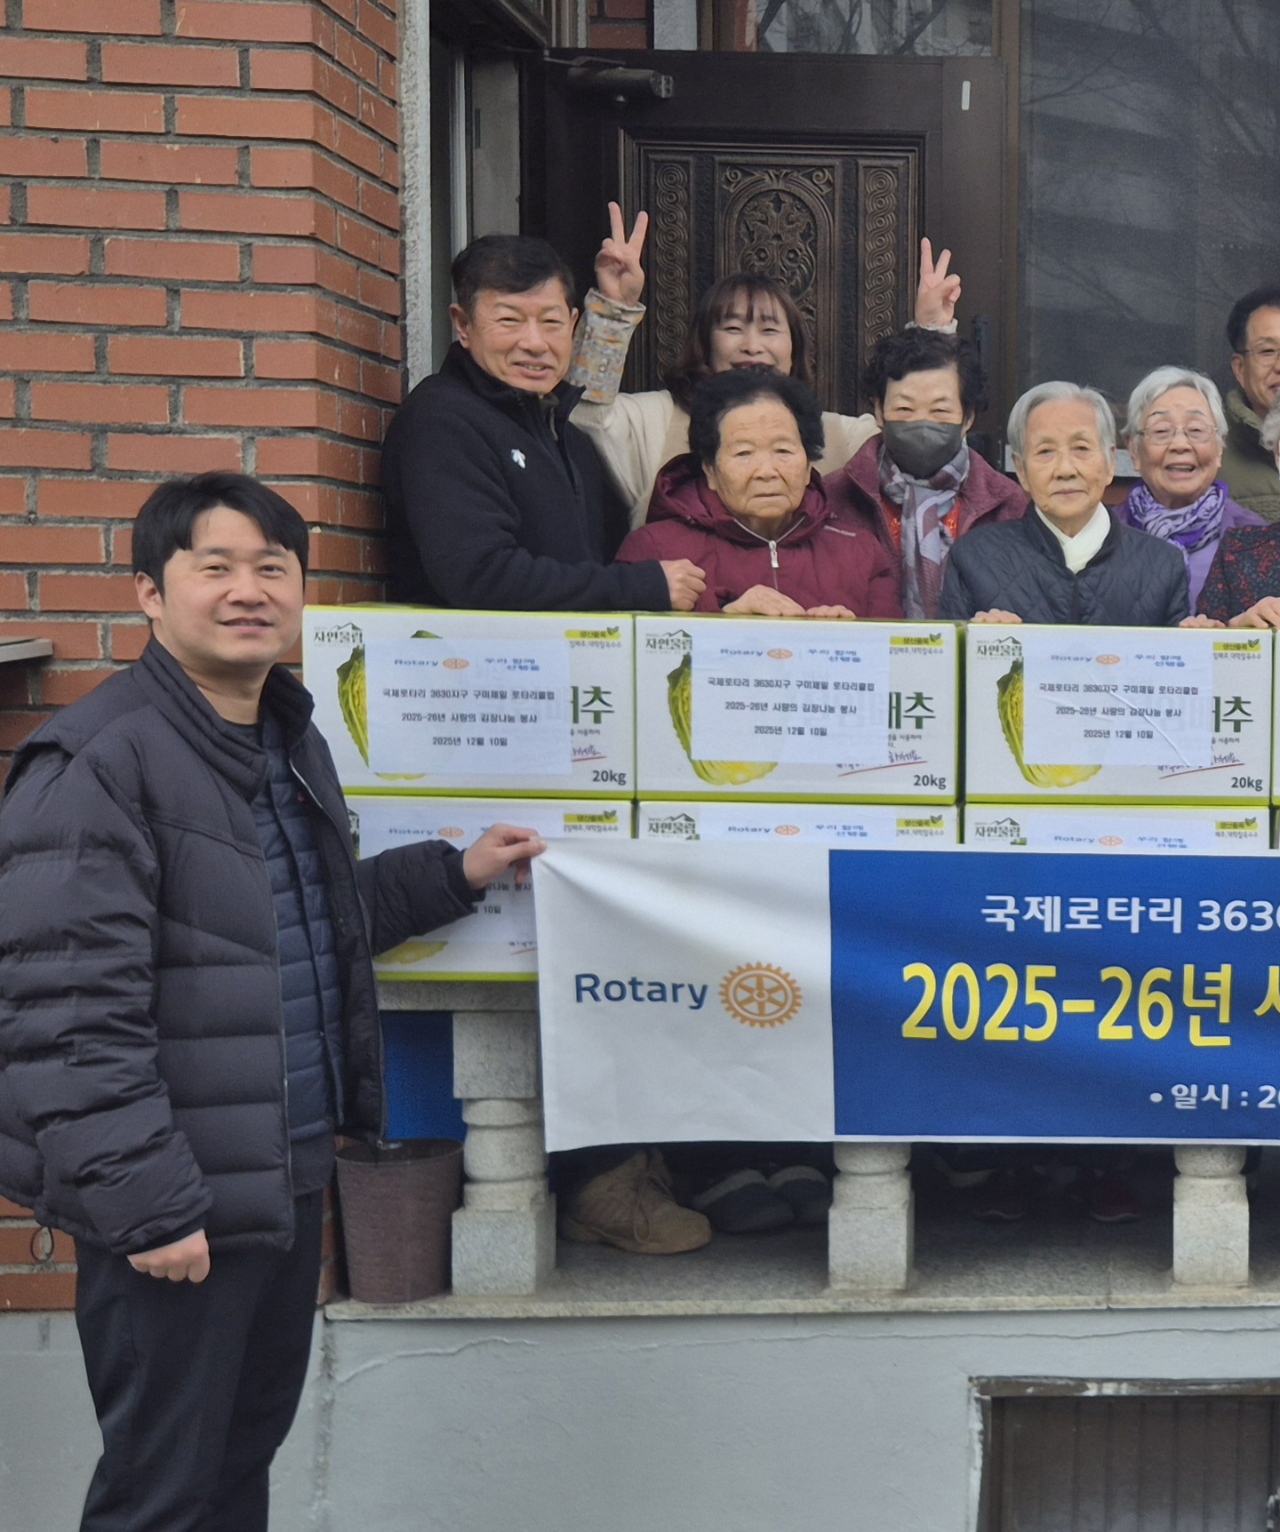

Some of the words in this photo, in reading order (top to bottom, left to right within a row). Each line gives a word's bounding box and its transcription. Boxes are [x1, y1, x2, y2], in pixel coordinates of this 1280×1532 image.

[720, 649, 763, 657] Rotary
[394, 658, 439, 667] Rotary
[1051, 655, 1092, 663] Rotary
[708, 677, 750, 687] 국제로타리
[754, 679, 791, 689] 3630지구
[795, 680, 829, 690] 구미제일
[833, 680, 875, 691] 로타리클럽
[1039, 684, 1079, 693] 국제로타리
[1083, 684, 1118, 694] 3630지구
[1123, 685, 1154, 694] 구미제일
[1158, 685, 1199, 695] 로타리클럽
[383, 689, 426, 699] 국제로타리
[430, 690, 468, 699] 3630지구
[473, 690, 507, 700] 구미제일
[512, 690, 555, 700] 로타리클럽
[725, 701, 768, 711] 2025-26년
[773, 702, 798, 712] 사랑의
[802, 703, 836, 713] 김장나눔
[840, 704, 857, 714] 봉사
[1056, 706, 1097, 715] 2025-26년
[1102, 707, 1125, 716] 사랑의
[1130, 707, 1161, 717] 김장나눔
[1166, 707, 1182, 718] 봉사
[402, 713, 446, 722] 2025-26년
[451, 713, 476, 723] 사랑의
[481, 713, 515, 723] 김장나눔
[520, 714, 537, 723] 봉사
[754, 726, 782, 735] 2025년
[787, 726, 805, 736] 12월
[810, 727, 827, 736] 10일
[1083, 729, 1110, 738] 2025년
[1115, 730, 1132, 739] 12월
[1137, 730, 1153, 739] 10일
[433, 736, 461, 746] 2025년
[467, 737, 484, 746] 12월
[489, 737, 507, 747] 10일
[592, 770, 626, 785] 20kg
[913, 774, 946, 790] 20kg
[1231, 776, 1263, 791] 20kg
[389, 828, 433, 836] Rotary
[728, 826, 770, 834] Rotary
[1054, 835, 1094, 844] Rotary
[484, 906, 502, 914] 10일
[981, 894, 1184, 934] 국제로타리
[574, 973, 708, 1010] Rotary
[900, 961, 1233, 1048] 2025-26년
[1171, 1084, 1230, 1110] 일시
